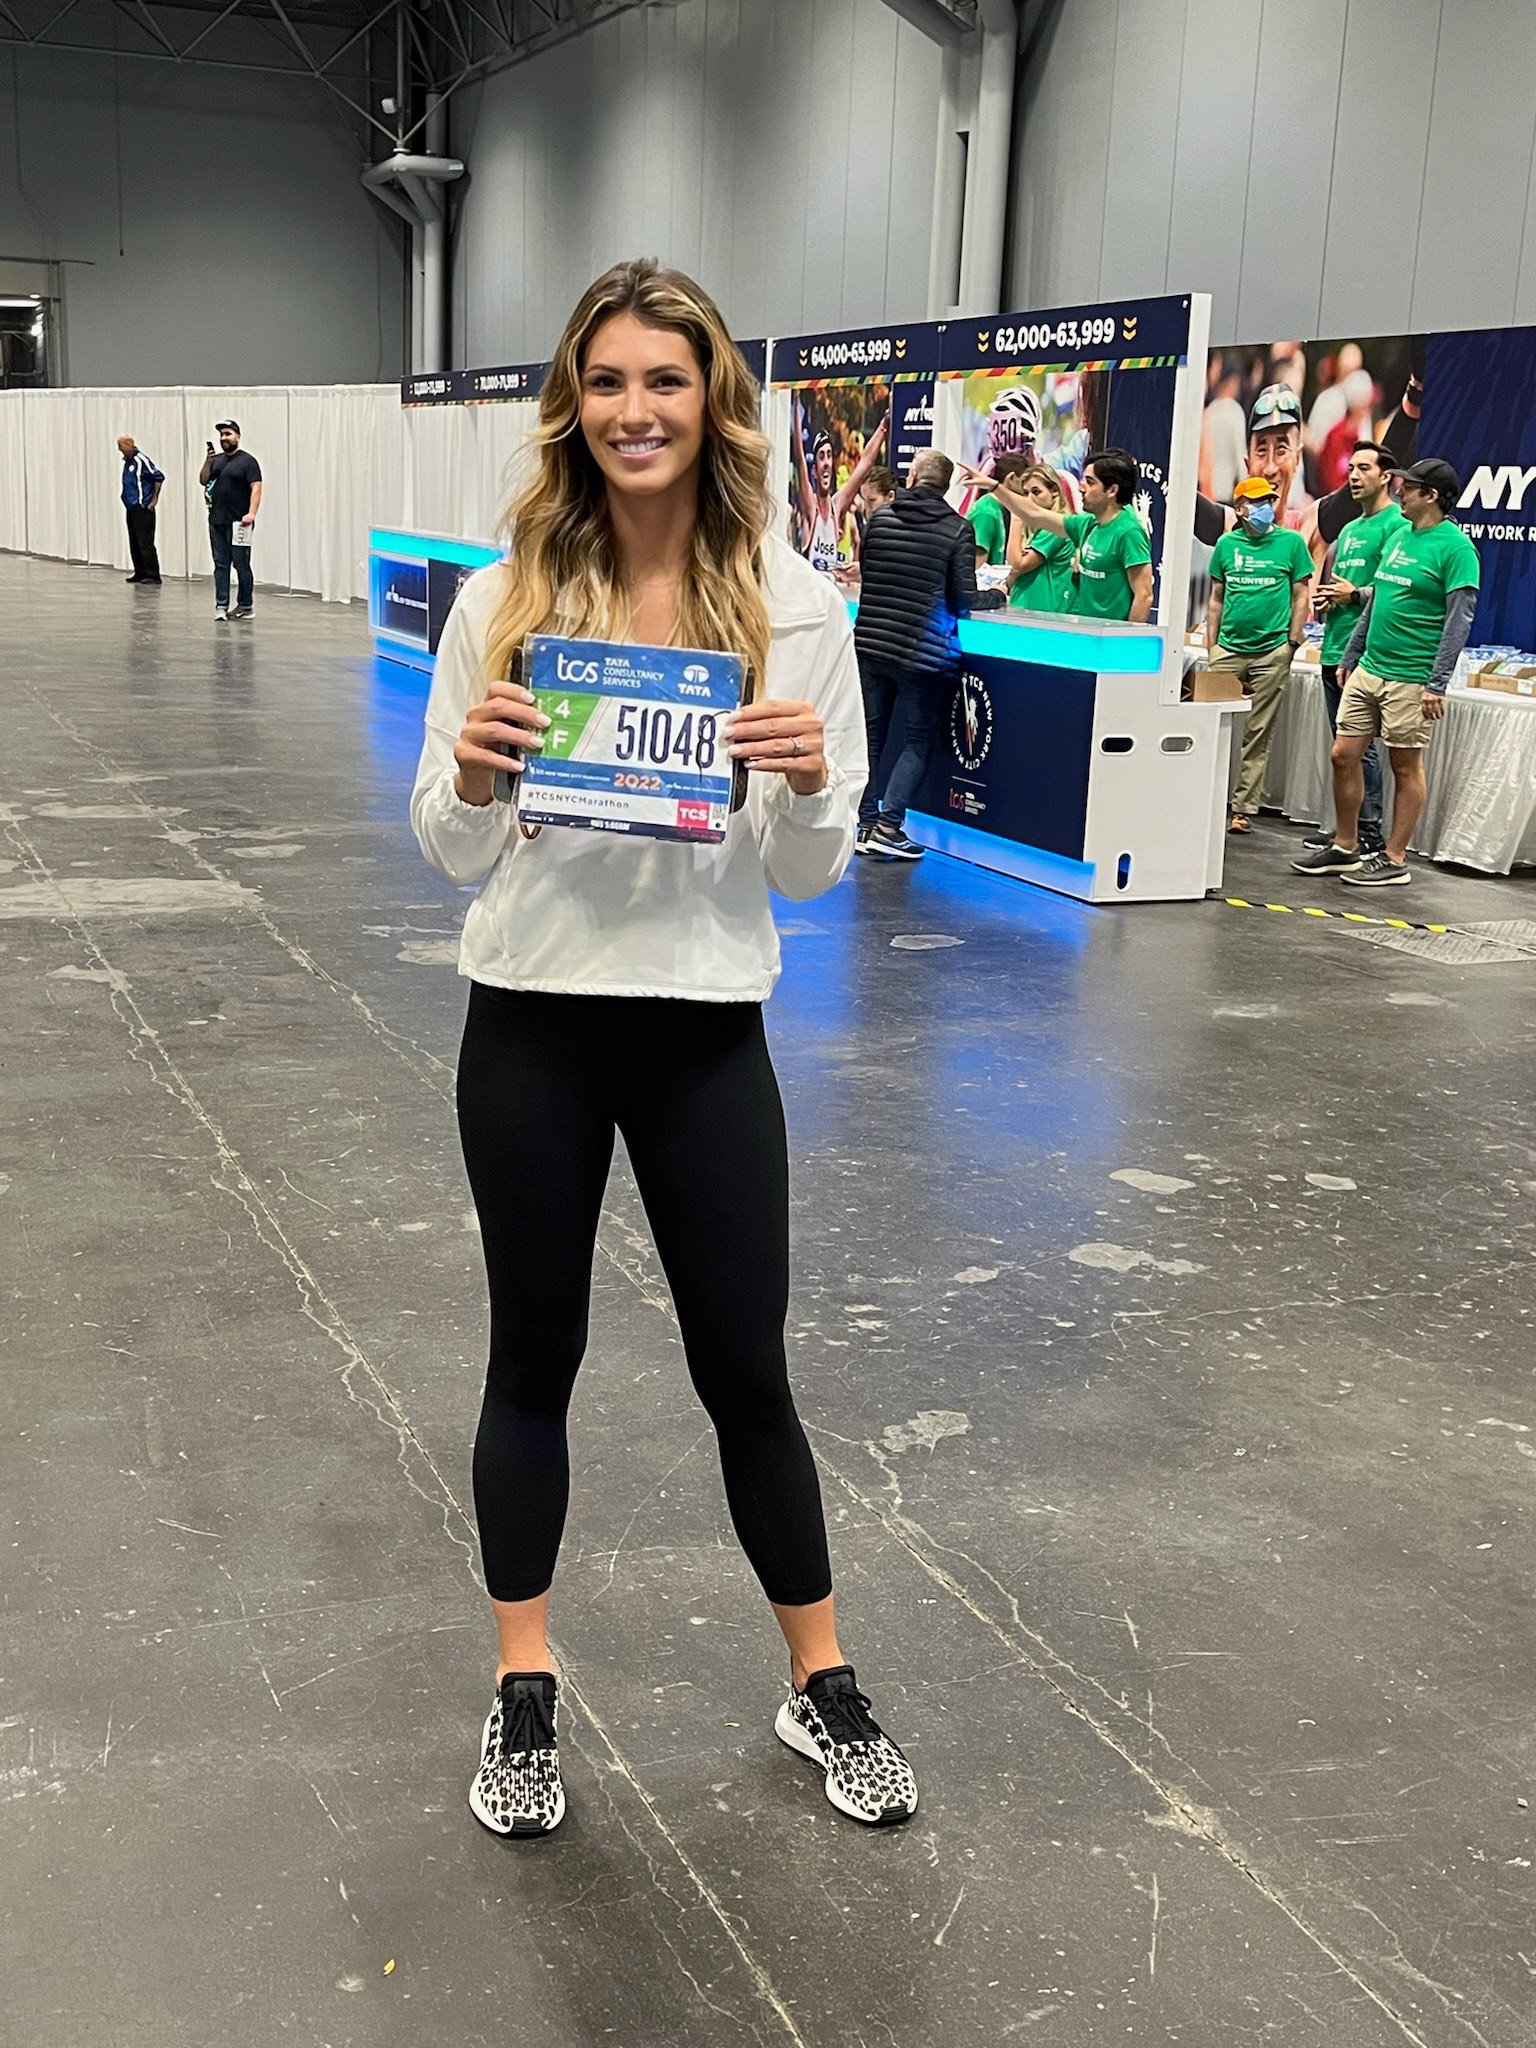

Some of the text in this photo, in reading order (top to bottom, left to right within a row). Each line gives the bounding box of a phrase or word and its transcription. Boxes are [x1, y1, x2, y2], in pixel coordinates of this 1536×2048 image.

[995, 317, 1115, 355] 62,000-63,999
[811, 338, 892, 369] 64,000-65,999
[992, 417, 1017, 452] 350
[1139, 462, 1162, 484] TCS
[1486, 524, 1526, 541] YORK
[814, 536, 835, 555] Jose
[557, 652, 599, 684] tcs
[604, 657, 631, 668] TATA
[602, 676, 642, 689] SERVICES
[603, 668, 665, 681] CONSULTANCY
[968, 674, 984, 692] TCS
[677, 683, 712, 698] TATA
[554, 698, 571, 719] 4
[982, 690, 993, 721] NEW
[552, 729, 569, 750] F
[615, 704, 717, 769] 51048
[979, 725, 993, 762] YORK
[613, 772, 662, 791] 2022
[527, 791, 630, 809] #TCSNYCMarathon
[679, 806, 708, 822] TCS
